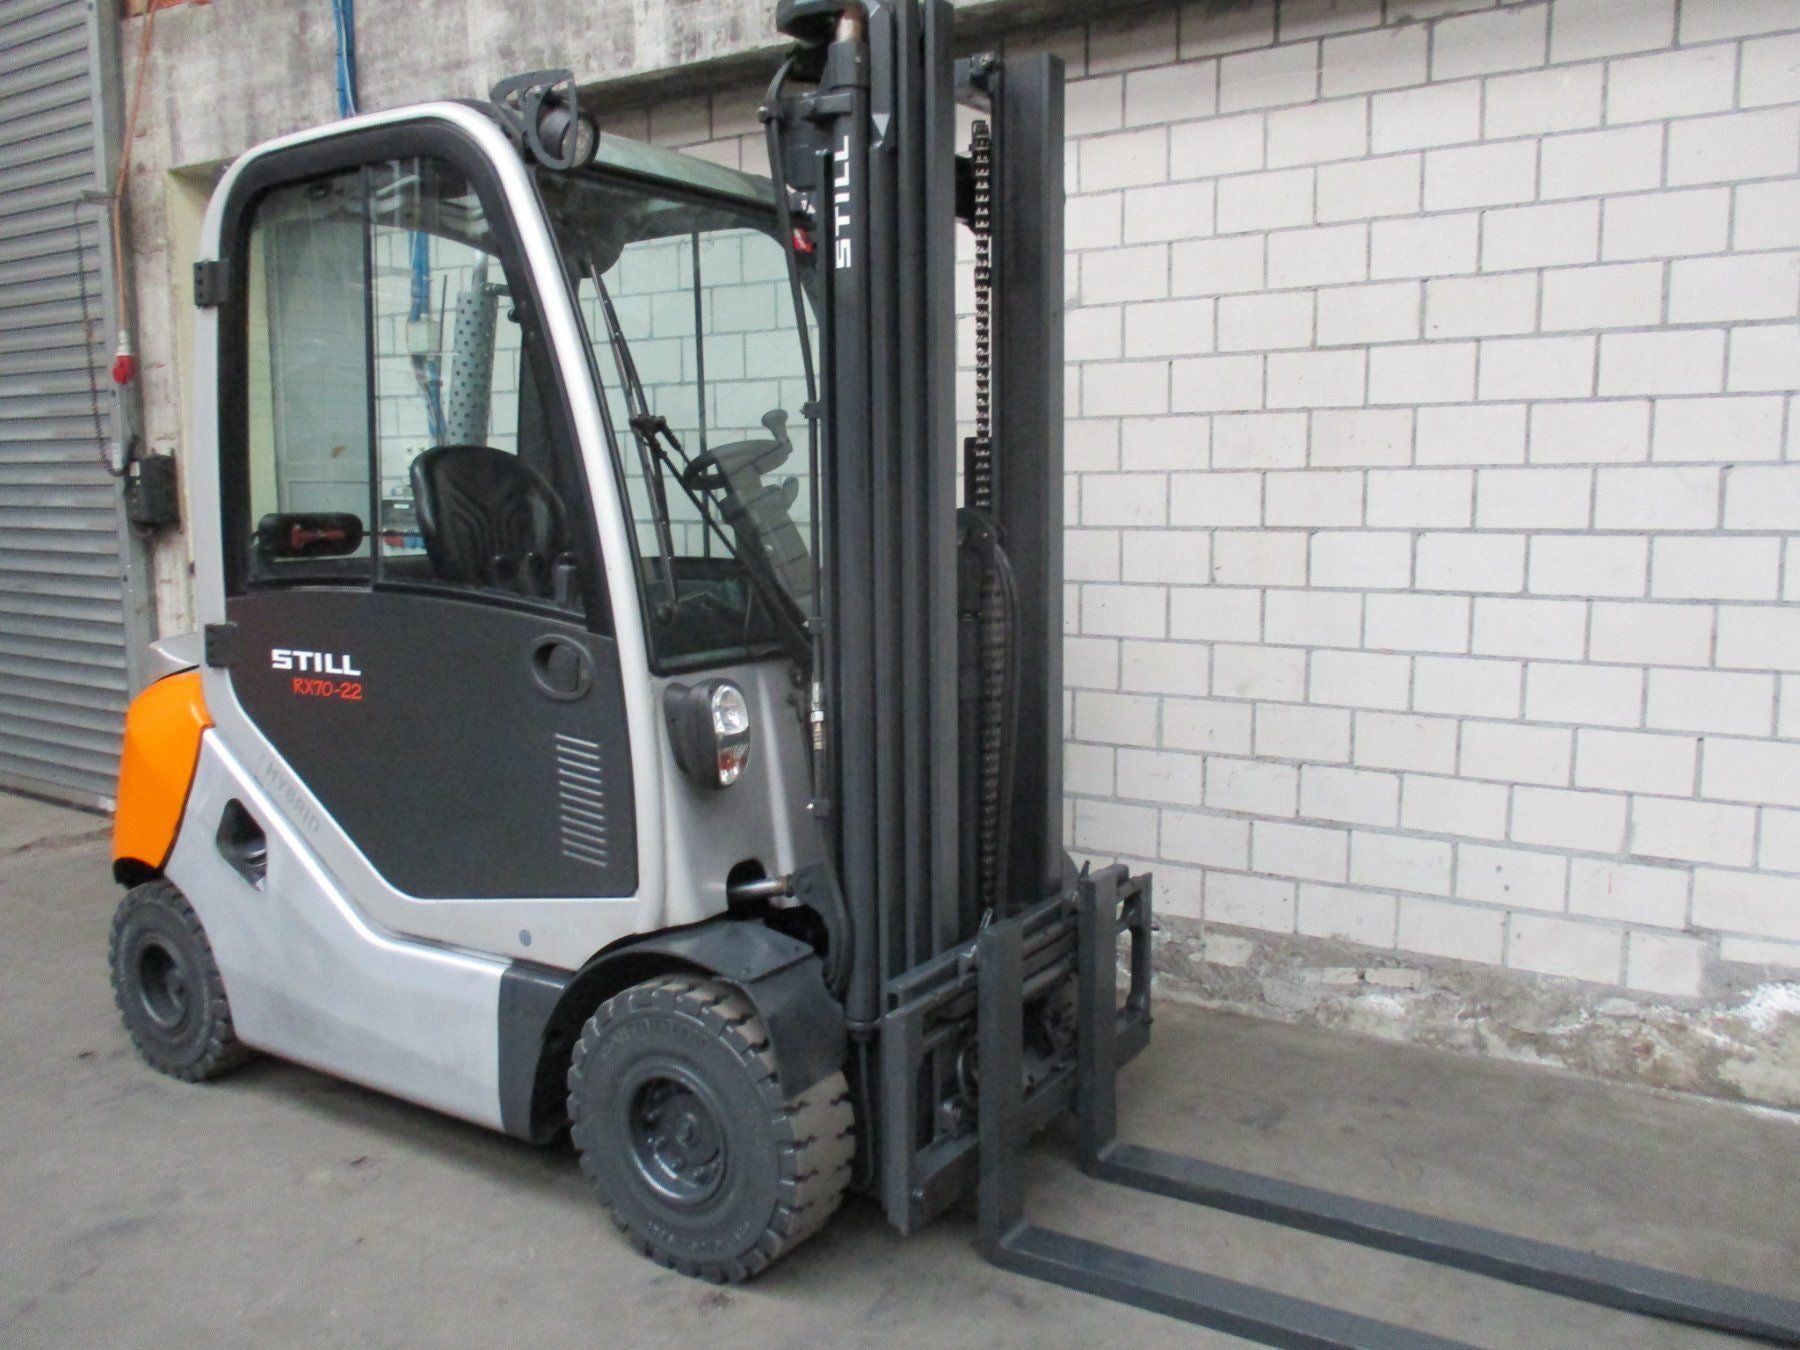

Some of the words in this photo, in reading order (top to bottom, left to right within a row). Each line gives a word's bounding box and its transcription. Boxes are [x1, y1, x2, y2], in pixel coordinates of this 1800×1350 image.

[834, 135, 851, 269] STILL
[271, 649, 362, 676] STILL
[293, 678, 362, 700] RX70-22
[265, 762, 320, 833] HYBRID
